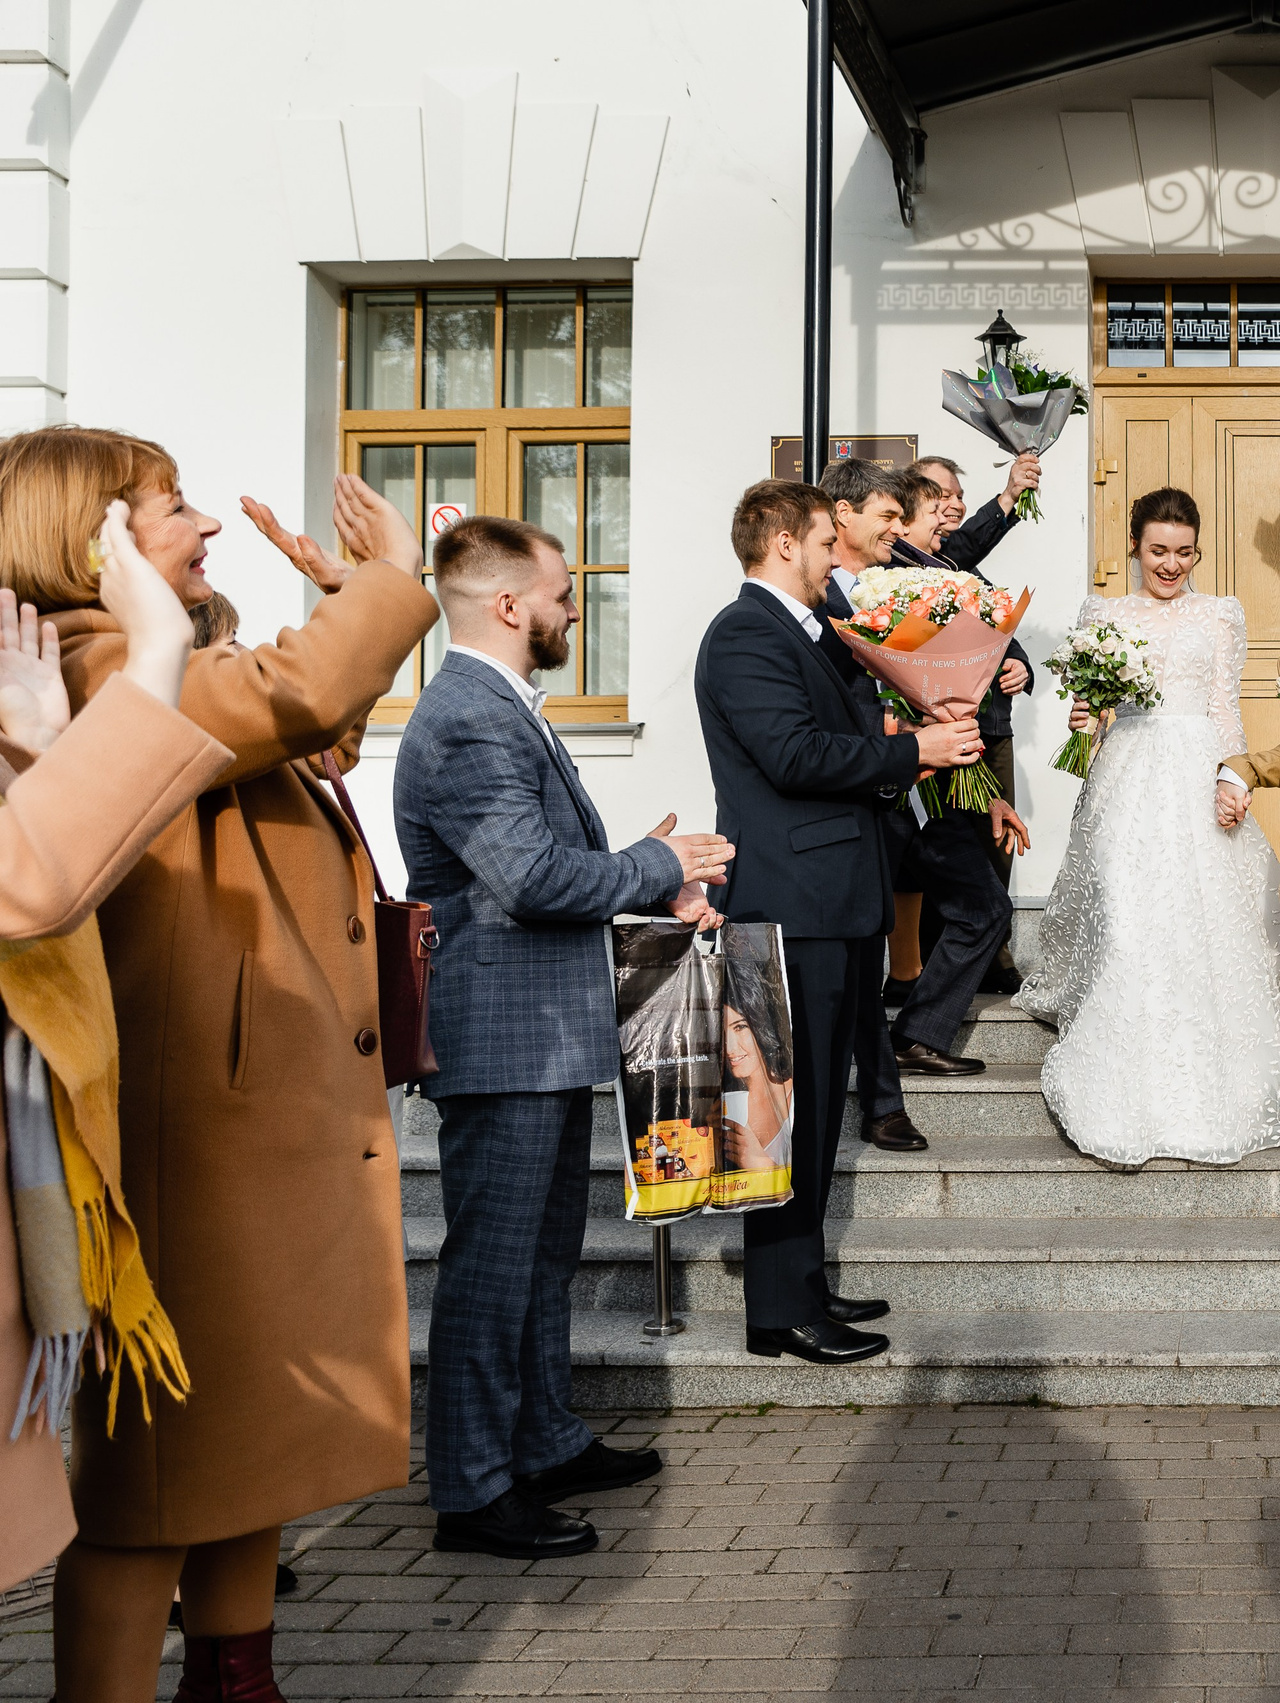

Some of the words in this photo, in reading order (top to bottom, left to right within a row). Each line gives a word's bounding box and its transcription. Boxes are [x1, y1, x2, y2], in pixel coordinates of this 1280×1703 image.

[875, 649, 908, 664] FLOWER
[911, 658, 928, 667] ART
[932, 660, 956, 668] NEWS
[959, 652, 988, 667] FLOWER
